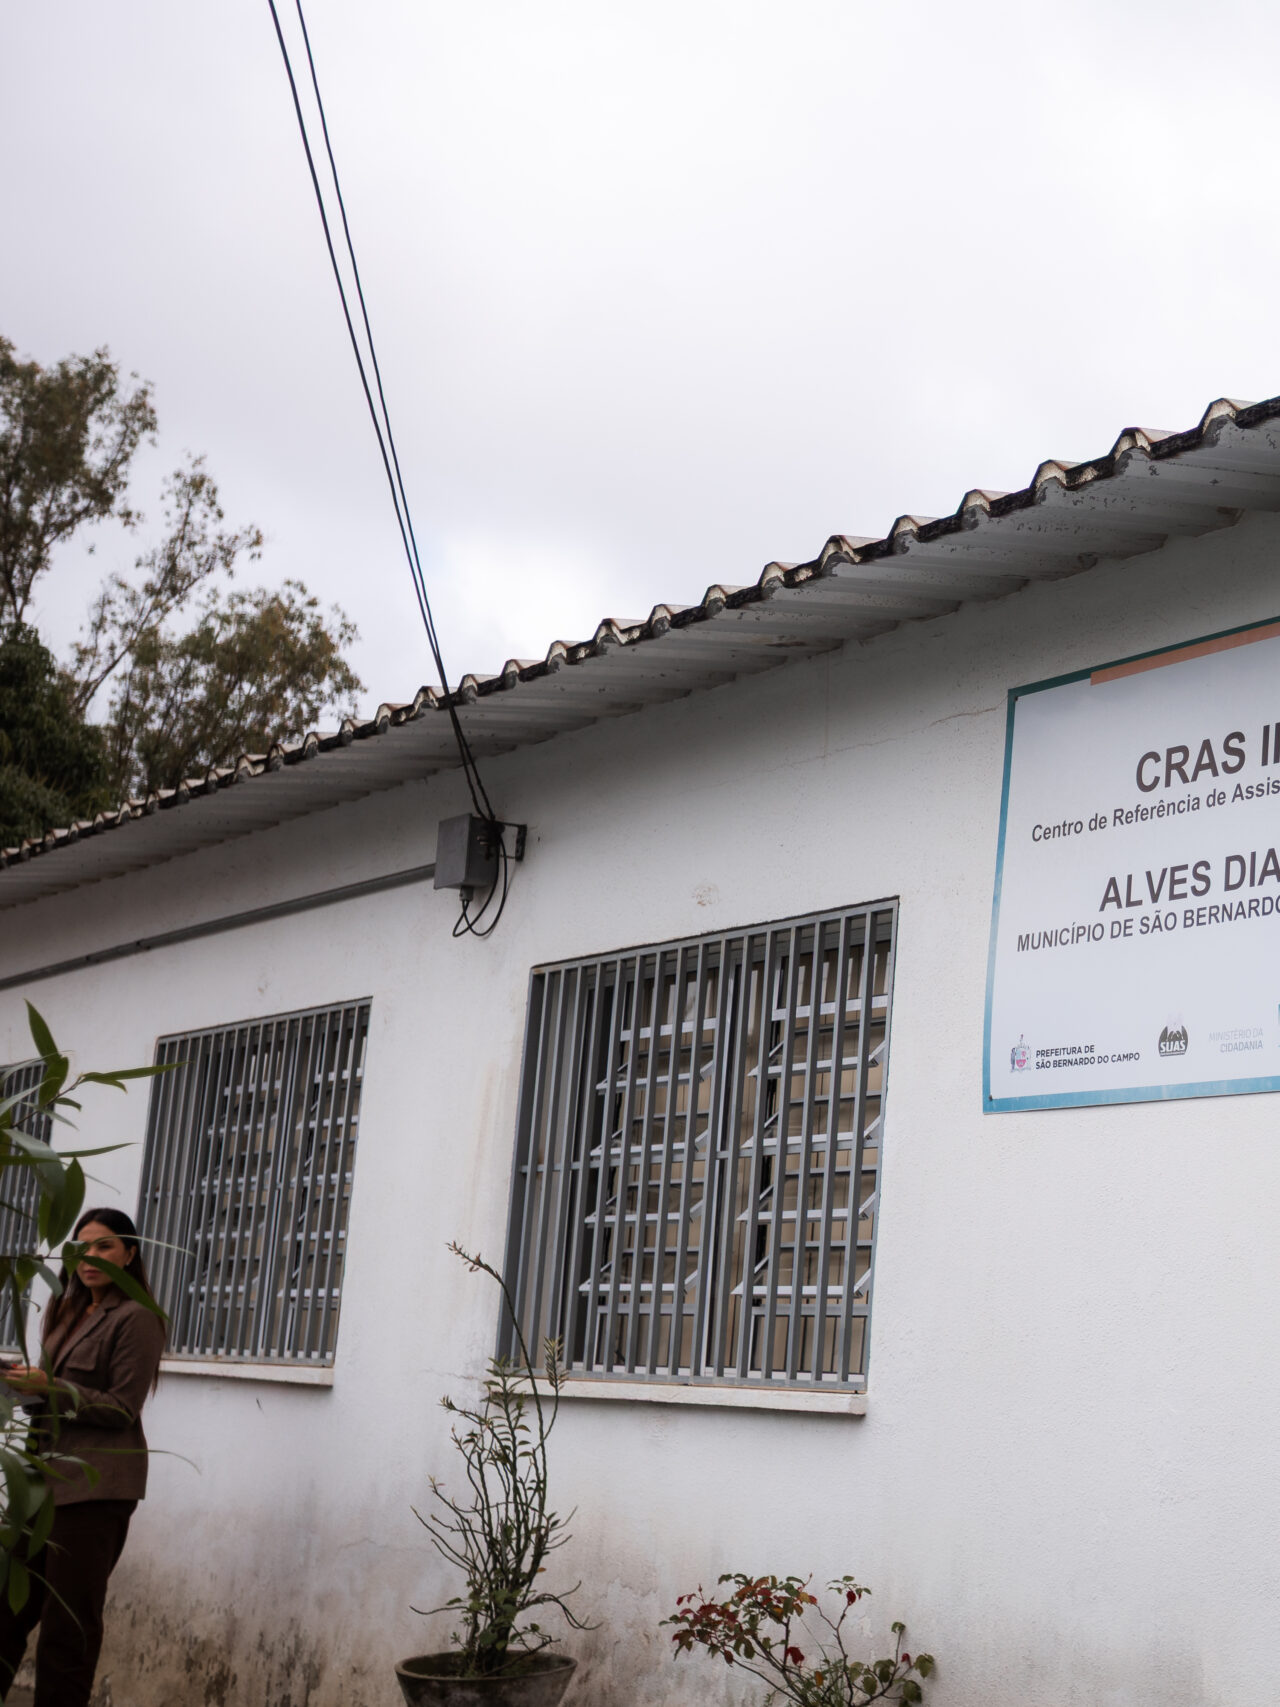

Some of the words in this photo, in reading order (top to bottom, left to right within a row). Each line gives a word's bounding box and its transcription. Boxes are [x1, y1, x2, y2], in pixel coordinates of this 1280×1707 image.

[1136, 731, 1246, 793] CRAS
[1032, 819, 1084, 843] Centro
[1088, 812, 1108, 832] de
[1112, 796, 1201, 828] Referência
[1206, 788, 1227, 809] de
[1099, 860, 1212, 913] ALVES
[1017, 920, 1105, 953] MUNICÍPIO
[1110, 917, 1134, 940] DE
[1138, 909, 1178, 936] SÃO
[1035, 1046, 1083, 1059] PREFEITURA
[1083, 1044, 1095, 1054] DE
[1035, 1057, 1052, 1070] SÃO
[1052, 1055, 1096, 1069] BERNARDO
[1097, 1054, 1110, 1065] DO
[1110, 1052, 1141, 1064] CAMPO
[1159, 1039, 1187, 1054] SUAS
[1219, 1039, 1264, 1054] CIDADANIA
